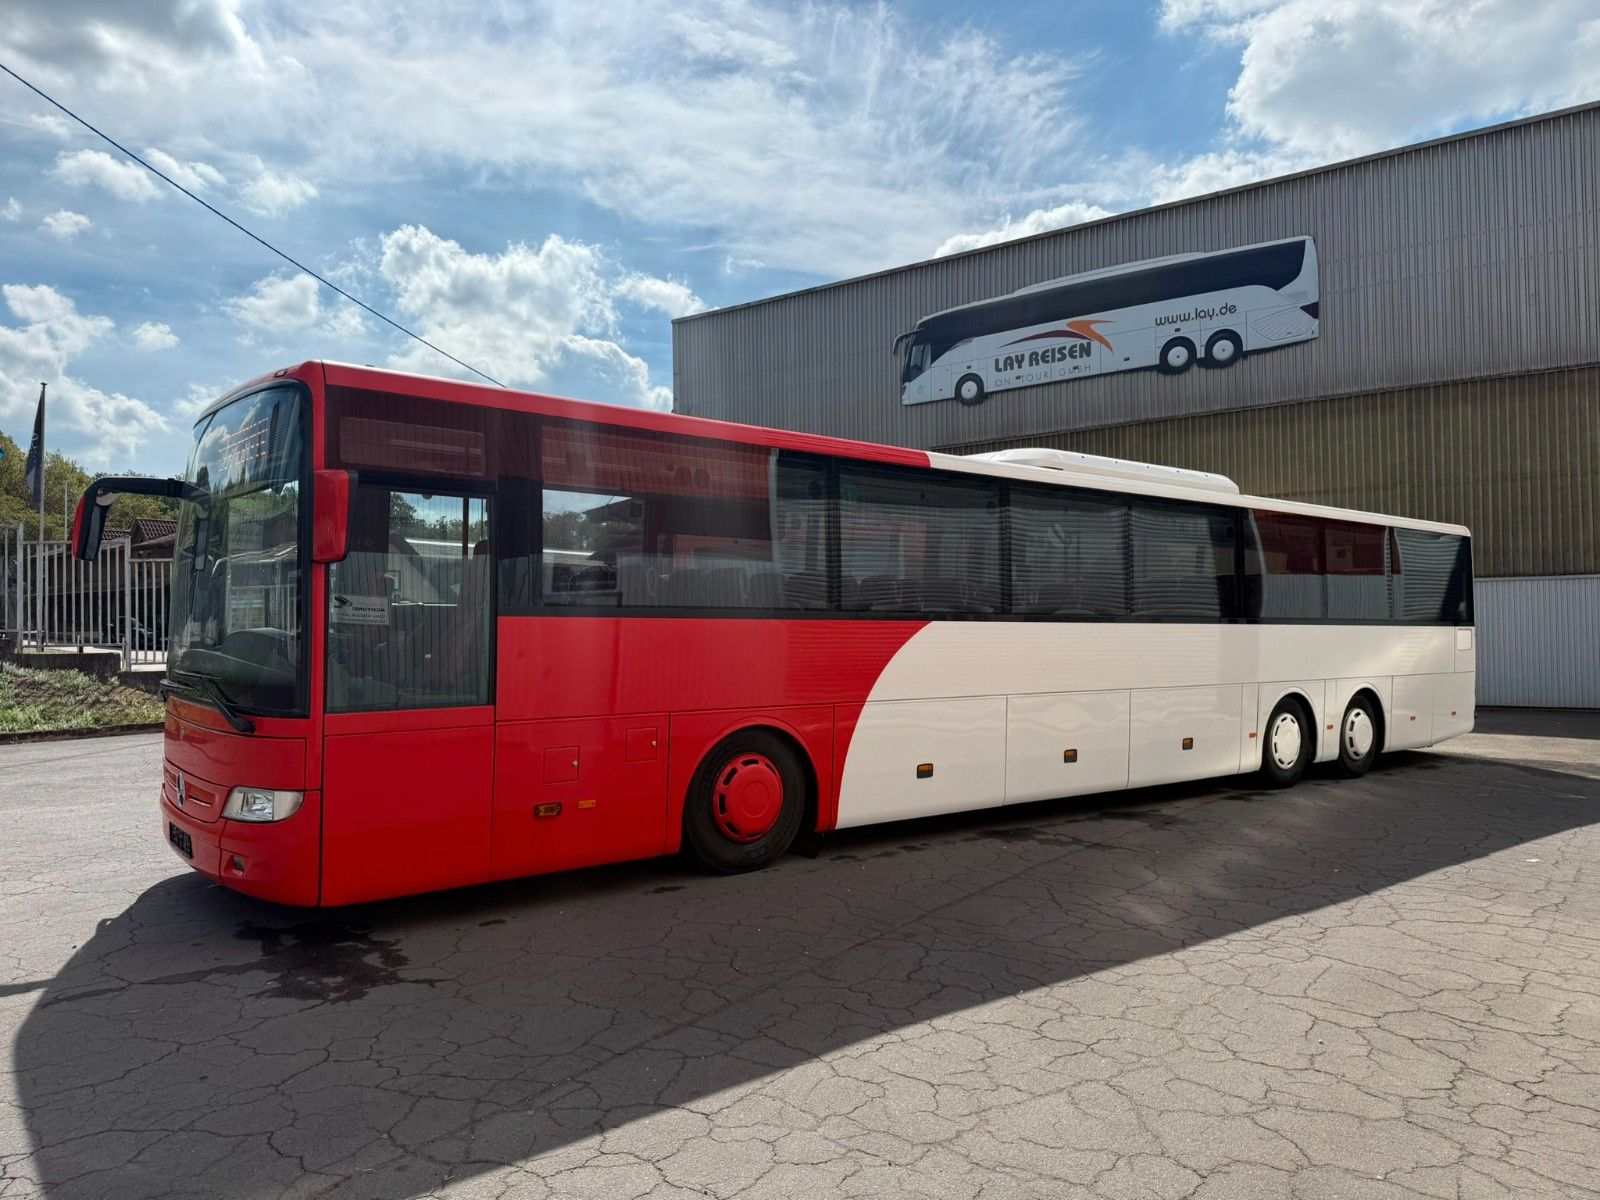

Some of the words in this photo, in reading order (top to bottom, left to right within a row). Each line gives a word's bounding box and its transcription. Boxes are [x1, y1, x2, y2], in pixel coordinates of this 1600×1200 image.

[1155, 302, 1237, 326] www.lay.de
[994, 354, 1025, 373] LAY
[1029, 341, 1092, 367] REISEN
[994, 378, 1011, 387] ON
[1019, 371, 1049, 383] TOUR
[1058, 364, 1092, 377] GMBH
